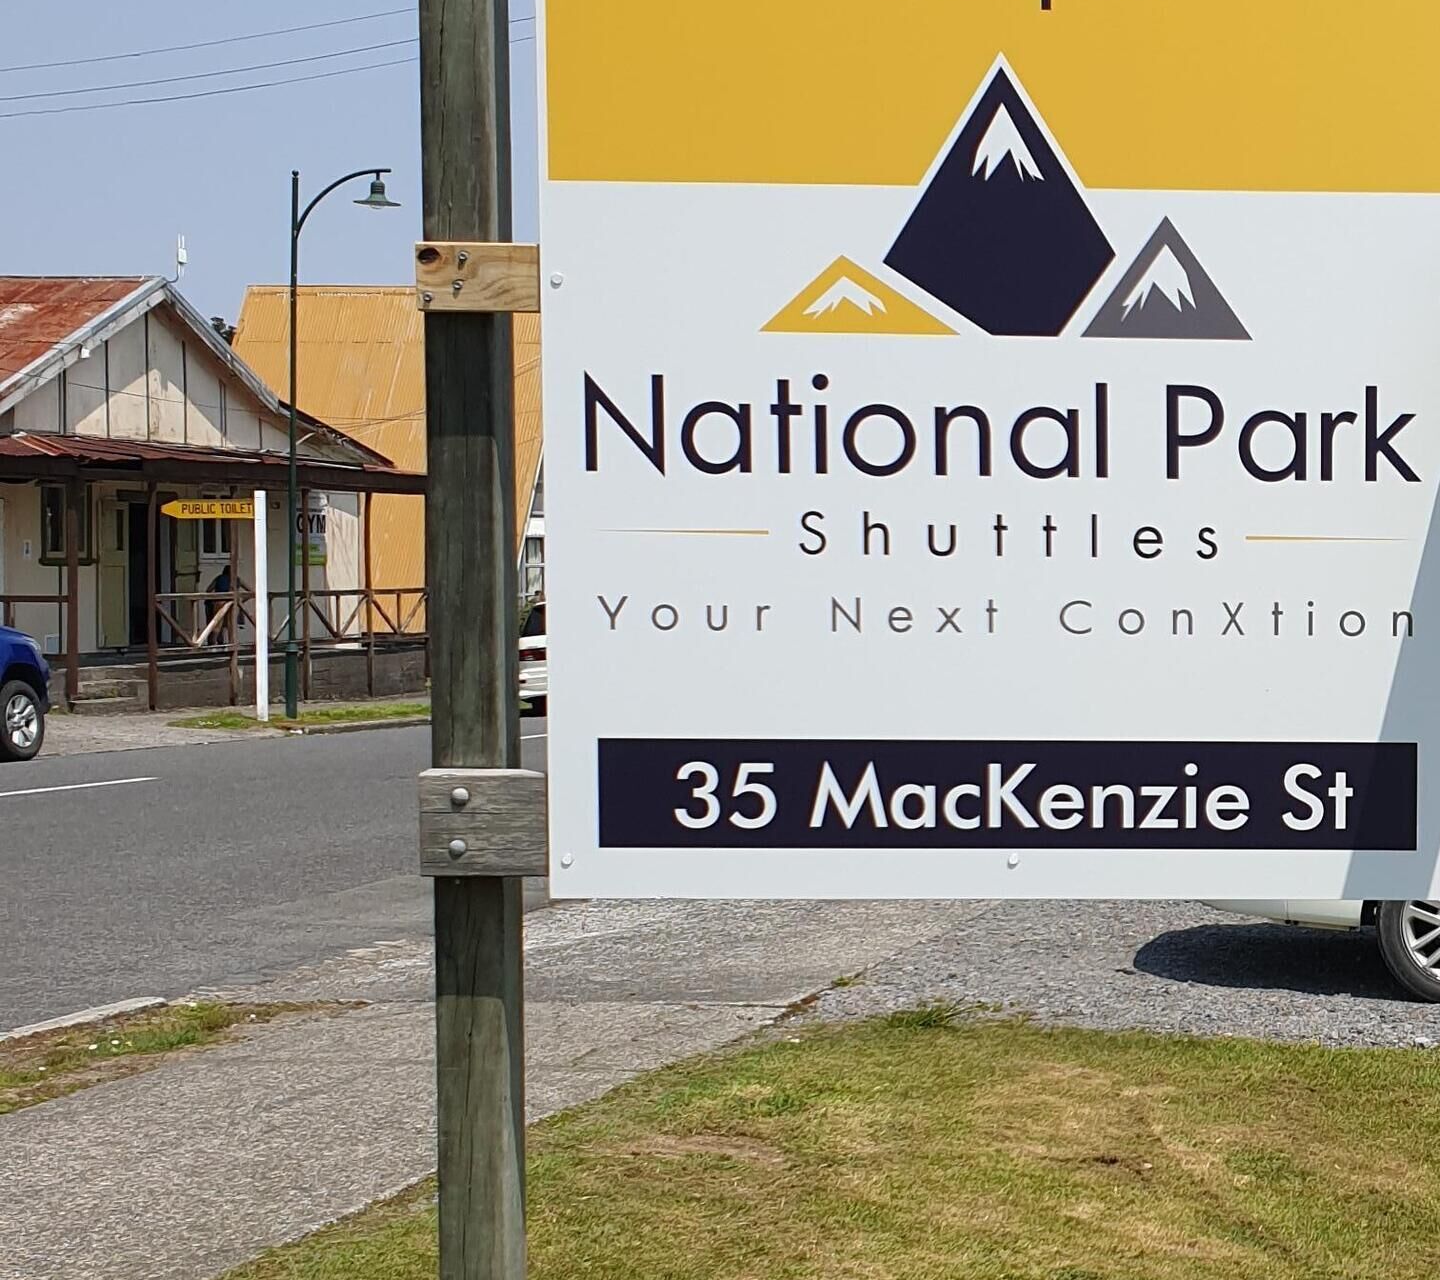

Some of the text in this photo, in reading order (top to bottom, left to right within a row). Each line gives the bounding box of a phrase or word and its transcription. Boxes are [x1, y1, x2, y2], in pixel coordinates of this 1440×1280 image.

[584, 371, 1423, 483] National Park
[181, 502, 252, 514] PUBLIC TOILET
[799, 510, 1219, 560] Shuttles
[596, 595, 1415, 638] Your Next ConXtion
[674, 761, 1354, 832] 35 MacKenzie St
